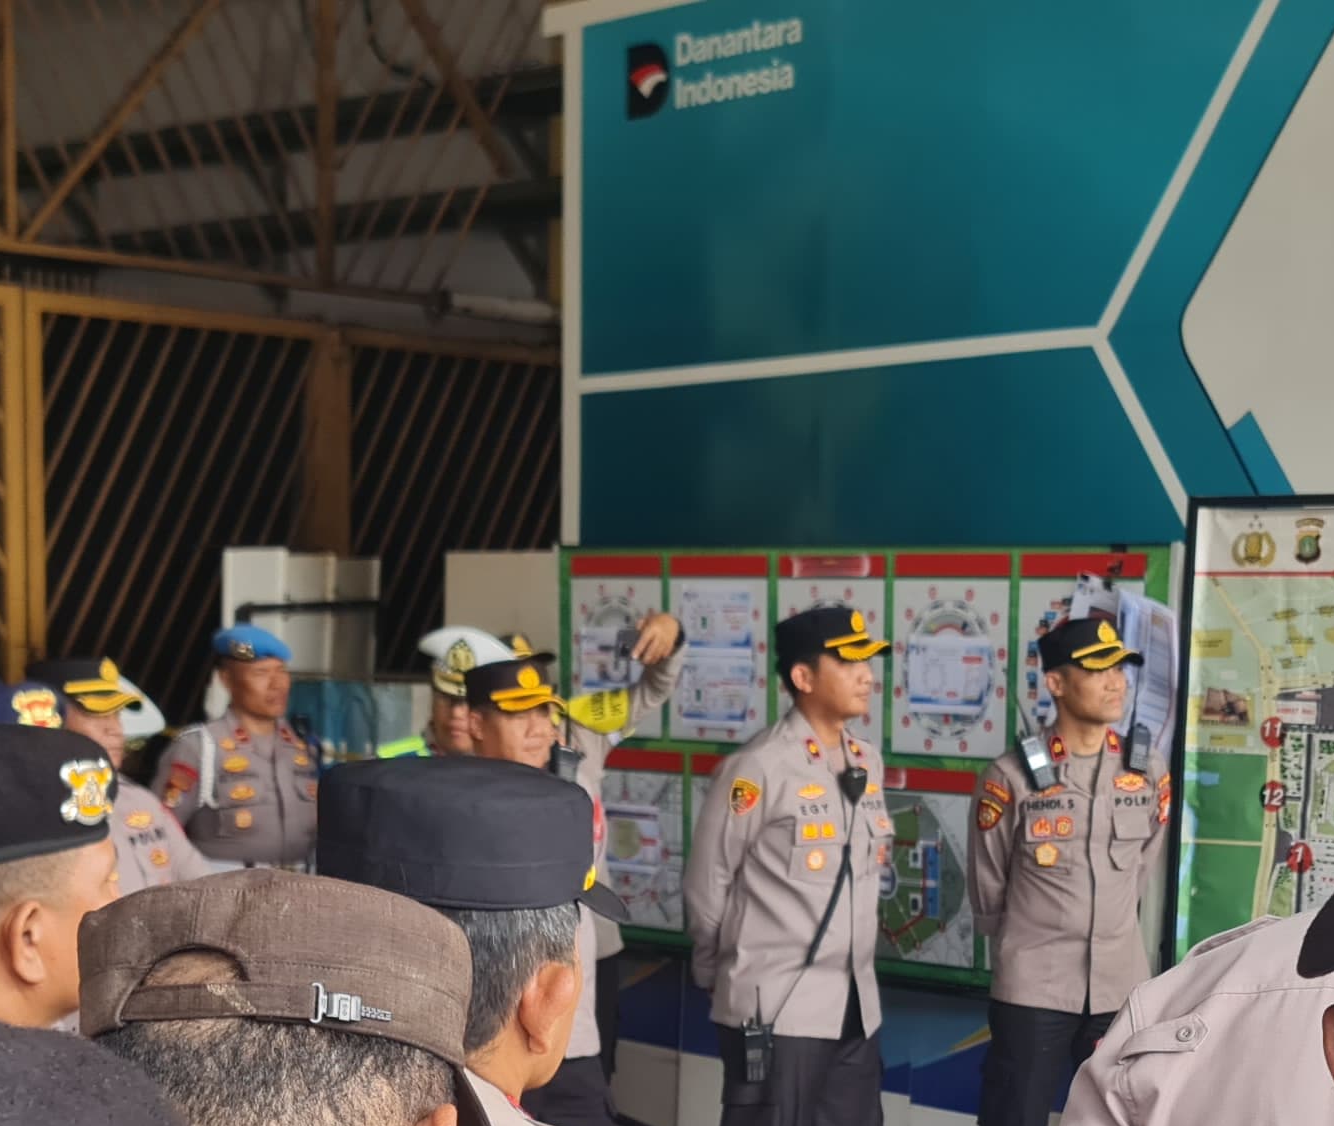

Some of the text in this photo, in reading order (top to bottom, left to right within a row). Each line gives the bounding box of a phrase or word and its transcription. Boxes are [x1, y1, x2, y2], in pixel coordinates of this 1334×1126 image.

[675, 18, 802, 67] Danantara
[675, 59, 795, 109] Indonesia
[1263, 720, 1282, 739] 11
[1115, 798, 1151, 808] POLRI
[1262, 789, 1285, 807] 12
[800, 803, 829, 816] EGY
